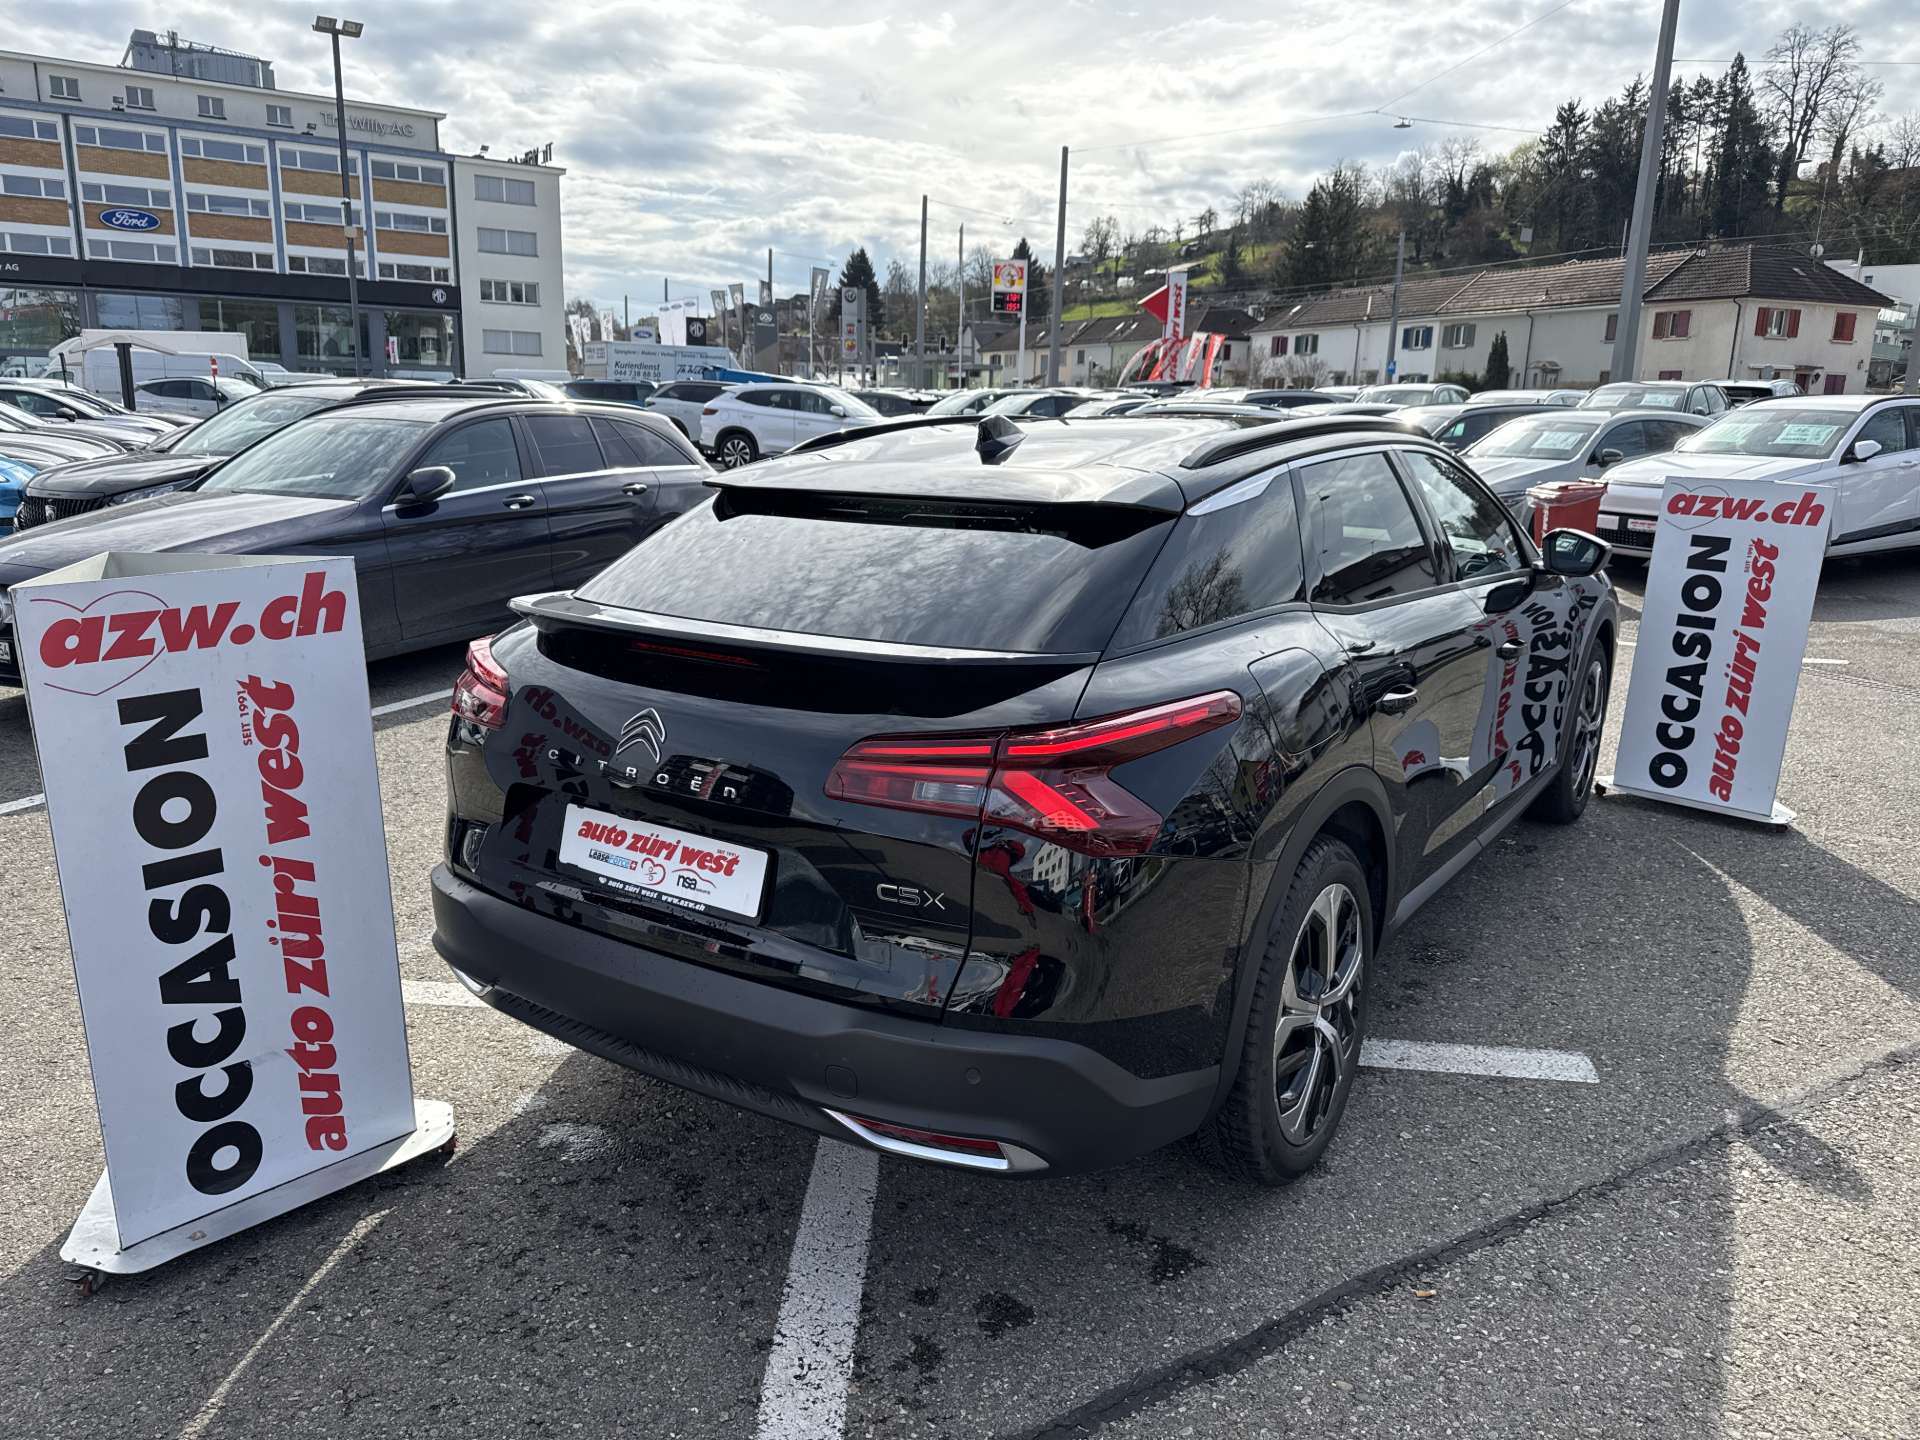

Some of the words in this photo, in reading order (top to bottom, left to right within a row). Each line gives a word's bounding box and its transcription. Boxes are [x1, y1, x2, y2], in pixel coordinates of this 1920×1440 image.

[349, 114, 385, 136] Willy
[391, 120, 415, 138] AG
[112, 210, 149, 228] Ford
[4, 263, 20, 271] AG
[614, 361, 660, 371] Kurierdienst
[1667, 492, 1825, 526] azw.ch
[1741, 537, 1779, 629] west
[39, 571, 346, 669] azw.ch
[1649, 534, 1732, 788] OCCASION
[1724, 629, 1761, 718] züri
[238, 689, 249, 720] 1991
[237, 674, 311, 845] west
[242, 722, 253, 746] SEIT
[1709, 715, 1743, 802] auto
[577, 820, 628, 848] auto
[626, 832, 681, 860] züri
[679, 846, 741, 877] west
[607, 880, 624, 890] auto
[641, 887, 658, 899] west
[661, 894, 706, 912] www.azw.ch
[676, 873, 697, 890] nsa
[117, 687, 263, 1195] OCCASION
[258, 854, 330, 998] züri
[284, 1005, 348, 1152] auto
